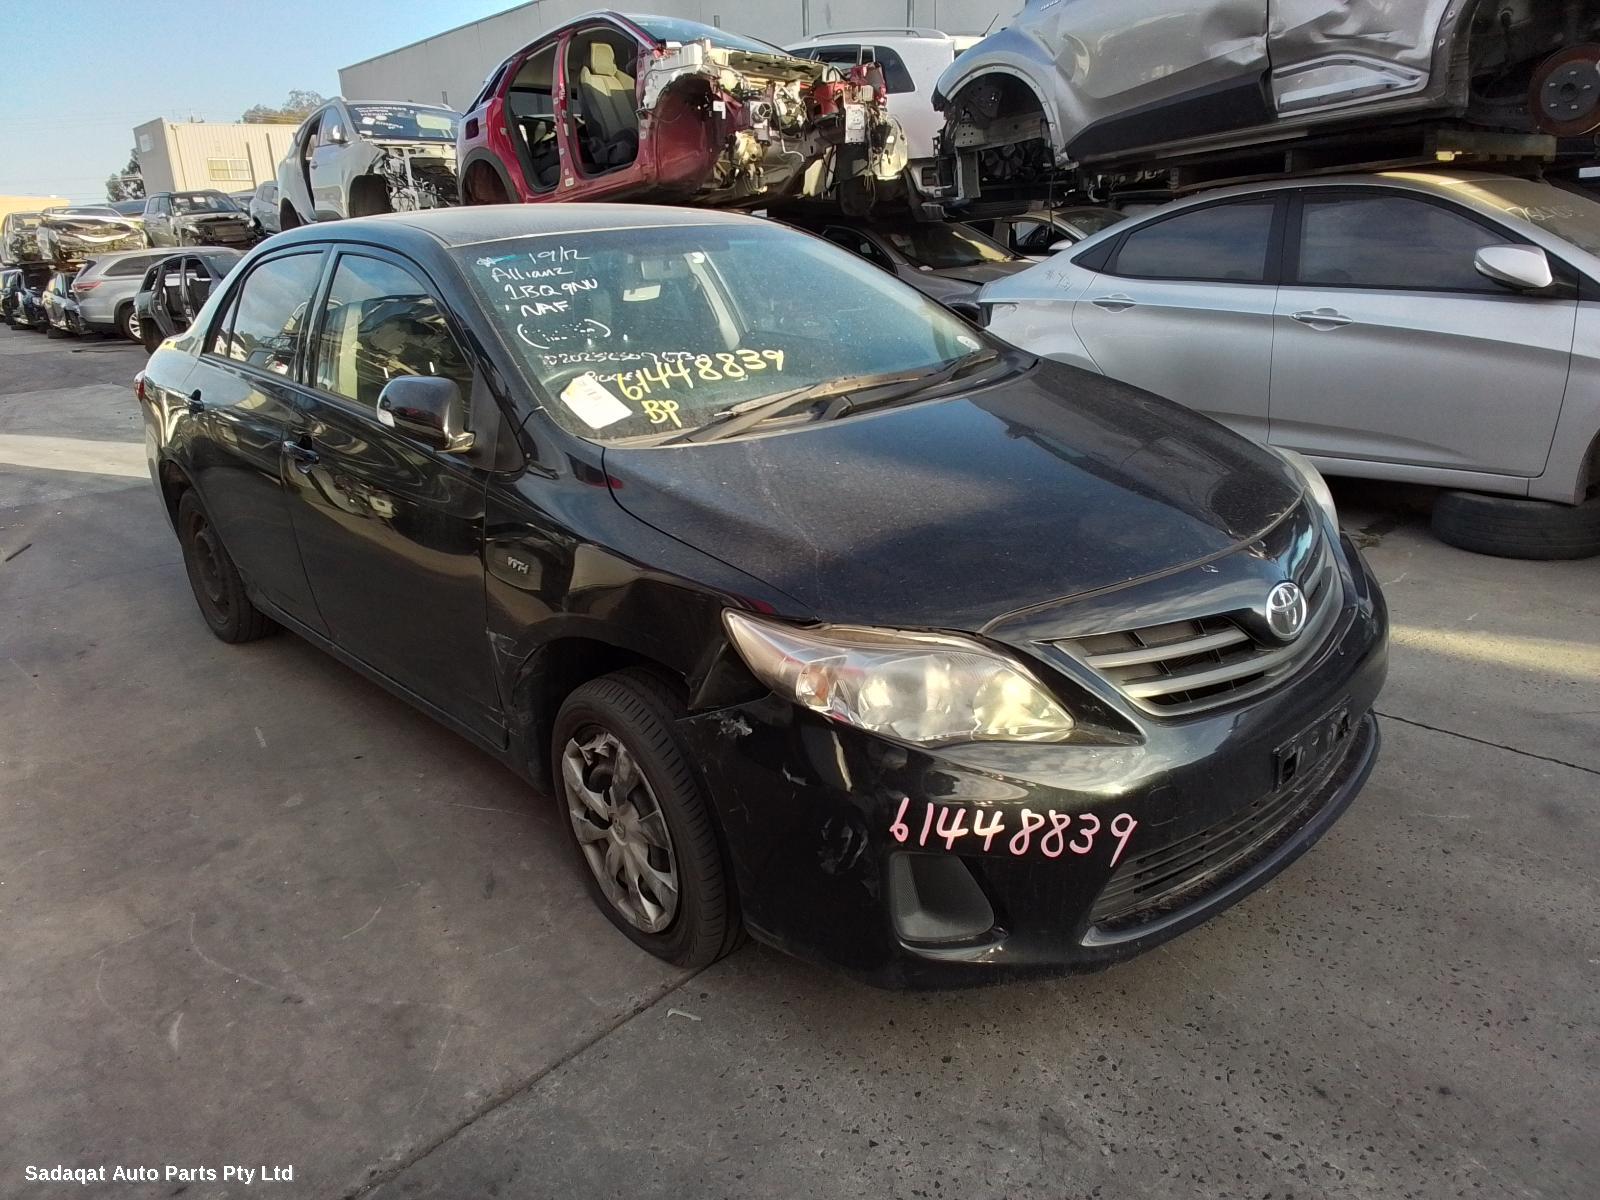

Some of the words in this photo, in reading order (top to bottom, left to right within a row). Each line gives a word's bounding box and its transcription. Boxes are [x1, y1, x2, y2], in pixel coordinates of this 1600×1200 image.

[491, 267, 574, 283] Allianz
[617, 349, 785, 401] 61448839
[641, 399, 682, 428] BP
[889, 796, 1138, 868] 61448839
